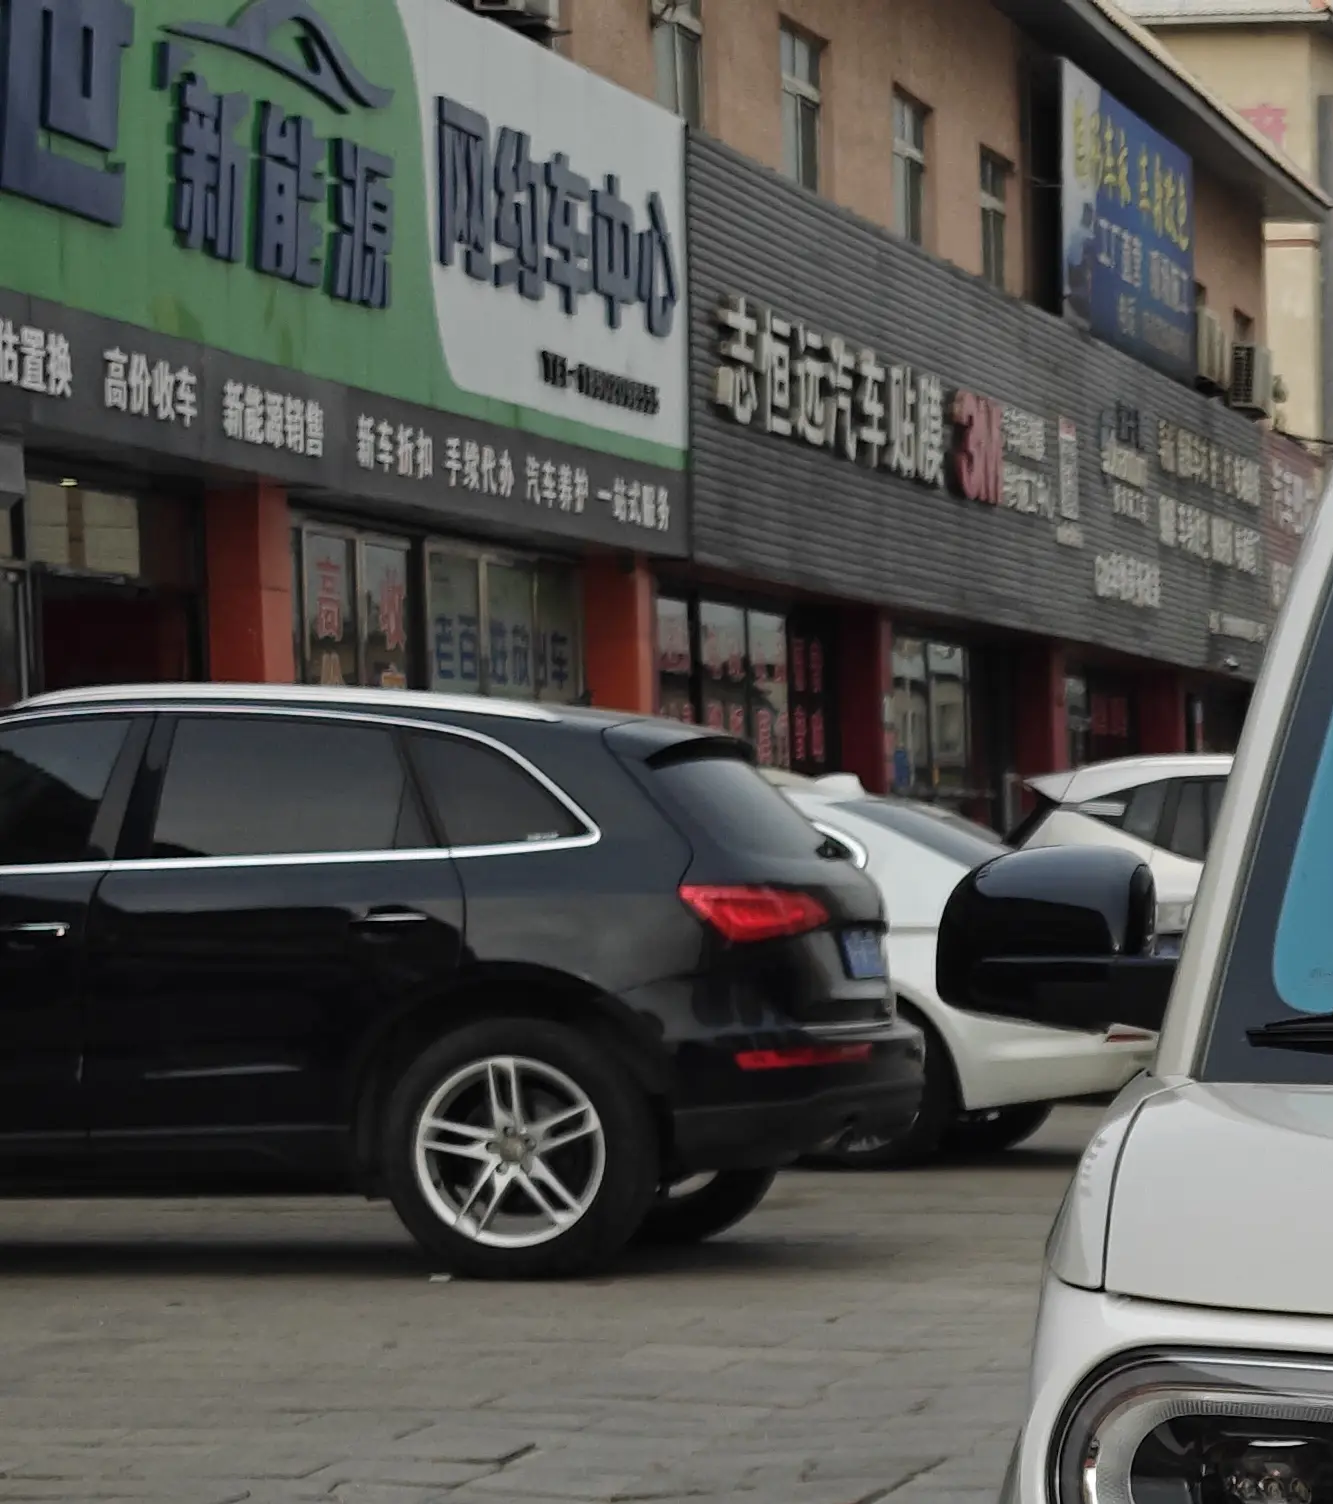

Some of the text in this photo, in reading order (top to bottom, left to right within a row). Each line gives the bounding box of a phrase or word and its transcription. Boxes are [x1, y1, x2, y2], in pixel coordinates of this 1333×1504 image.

[174, 72, 392, 309] 新能源
[437, 96, 677, 337] 网约车中心
[103, 346, 198, 428] 高价收车
[222, 379, 324, 458] 新能源销售
[356, 413, 434, 480] 新车折扣
